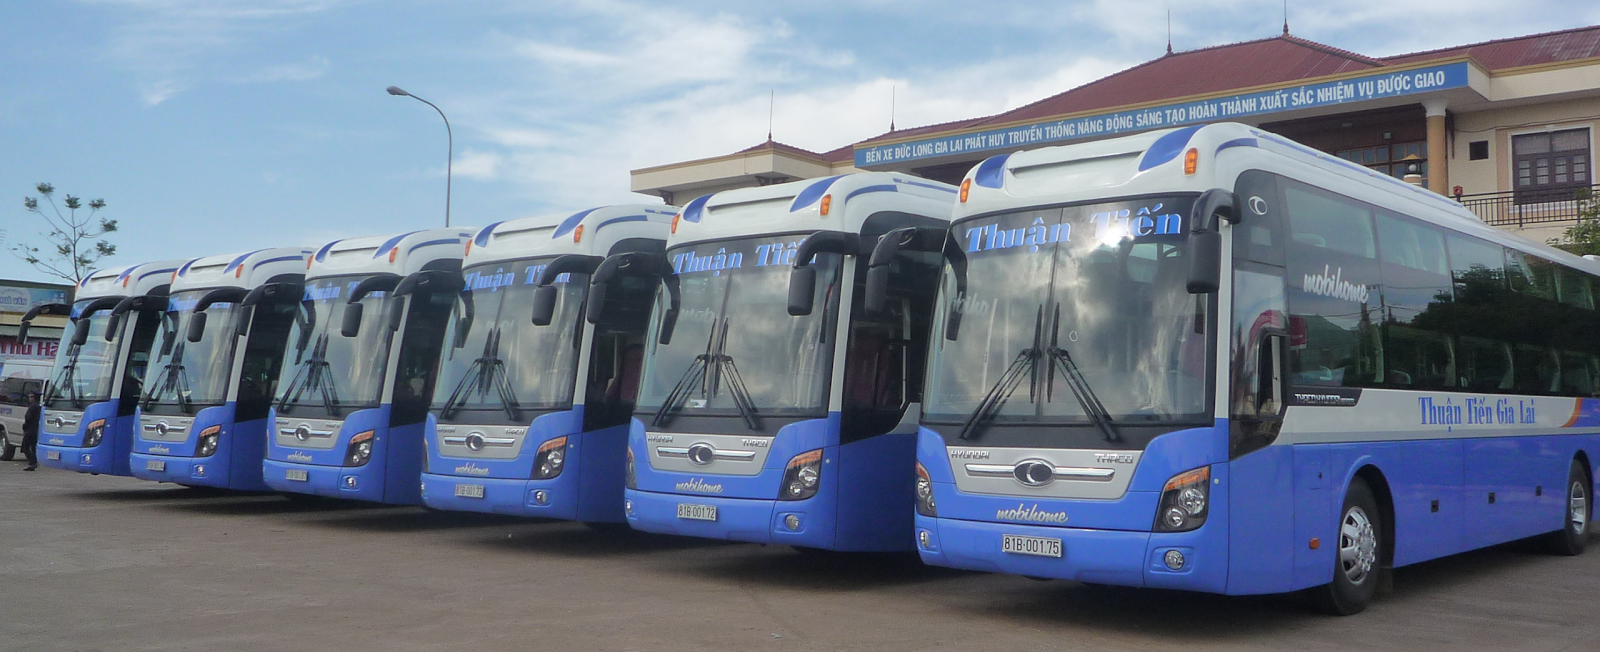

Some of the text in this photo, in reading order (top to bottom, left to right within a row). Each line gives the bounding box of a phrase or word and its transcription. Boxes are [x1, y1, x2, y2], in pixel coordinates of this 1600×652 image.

[866, 71, 1445, 163] BẾN XE ĐỨC LONG GIA LAI PHÁT HUY TRUYỀN THỐNG NĂNG ĐỘNG SÁNG TẠO HOÀN THÀNH XUẤT SẮC NHIỆM VỤ ĐƯỢC GIAO
[966, 203, 1181, 253] Thuận Tiến
[672, 238, 816, 277] Thuận Tiế
[463, 267, 515, 292] Thuận
[1303, 264, 1369, 303] mobihome
[1418, 397, 1535, 432] Thuận Tiến Gia Lai
[951, 451, 990, 460] HYUNDAI
[1095, 453, 1133, 464] THACO
[674, 478, 724, 494] mobihome
[996, 503, 1069, 523] mobihome
